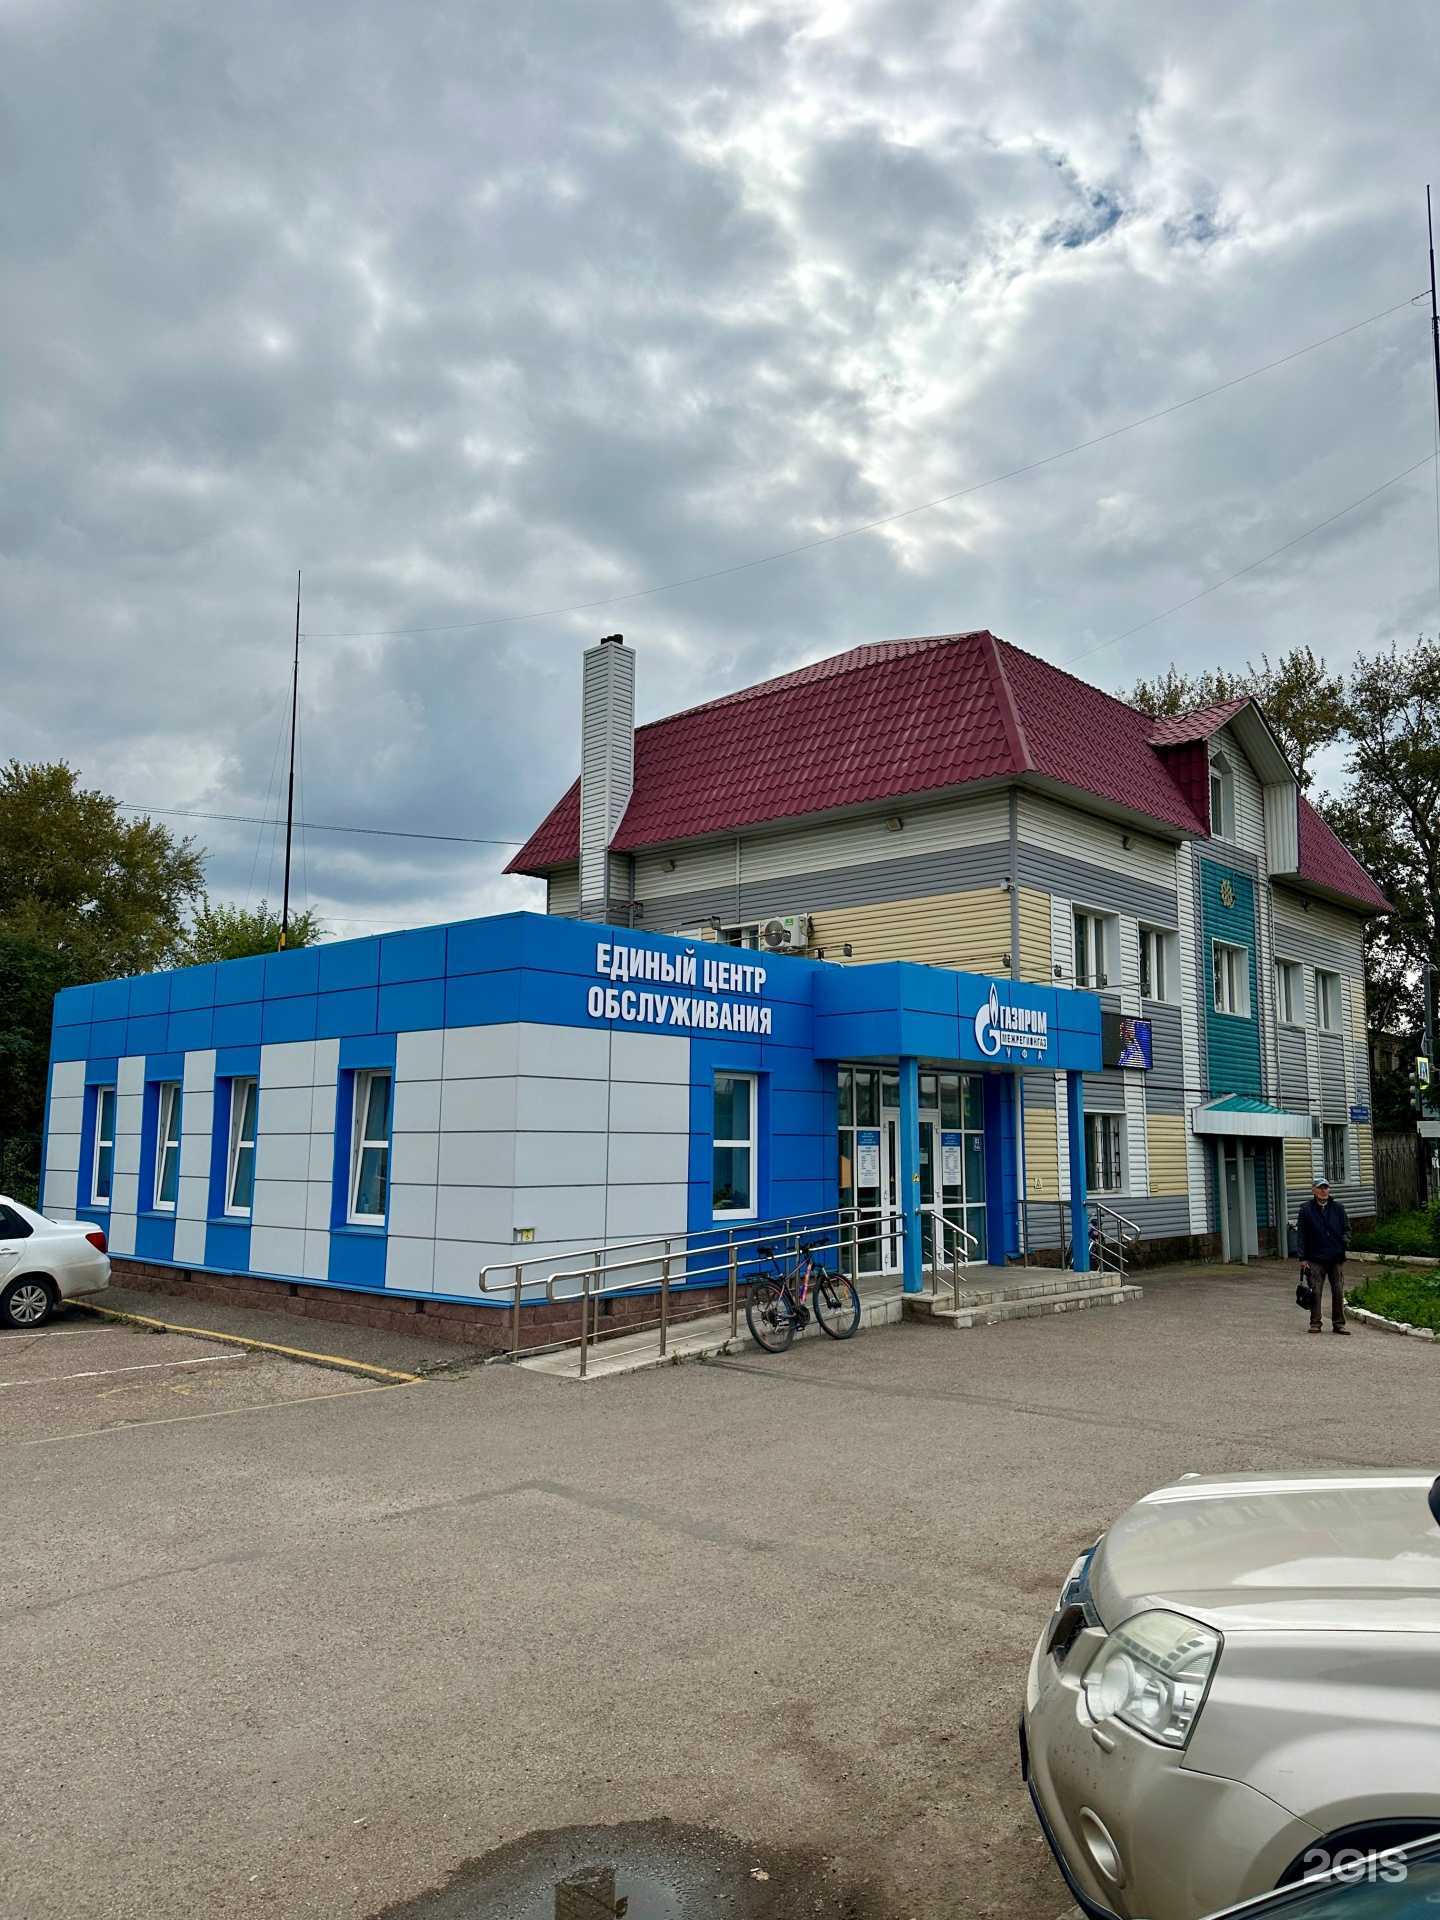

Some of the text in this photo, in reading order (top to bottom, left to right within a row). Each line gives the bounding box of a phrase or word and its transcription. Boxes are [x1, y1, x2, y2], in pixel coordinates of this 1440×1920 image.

[596, 942, 767, 994] ЕДИНЫЙ ЦЕНТР
[587, 985, 772, 1035] ОБСЛУЖИВАНИЯ
[1000, 1005, 1047, 1034] ГАЗПРОМ
